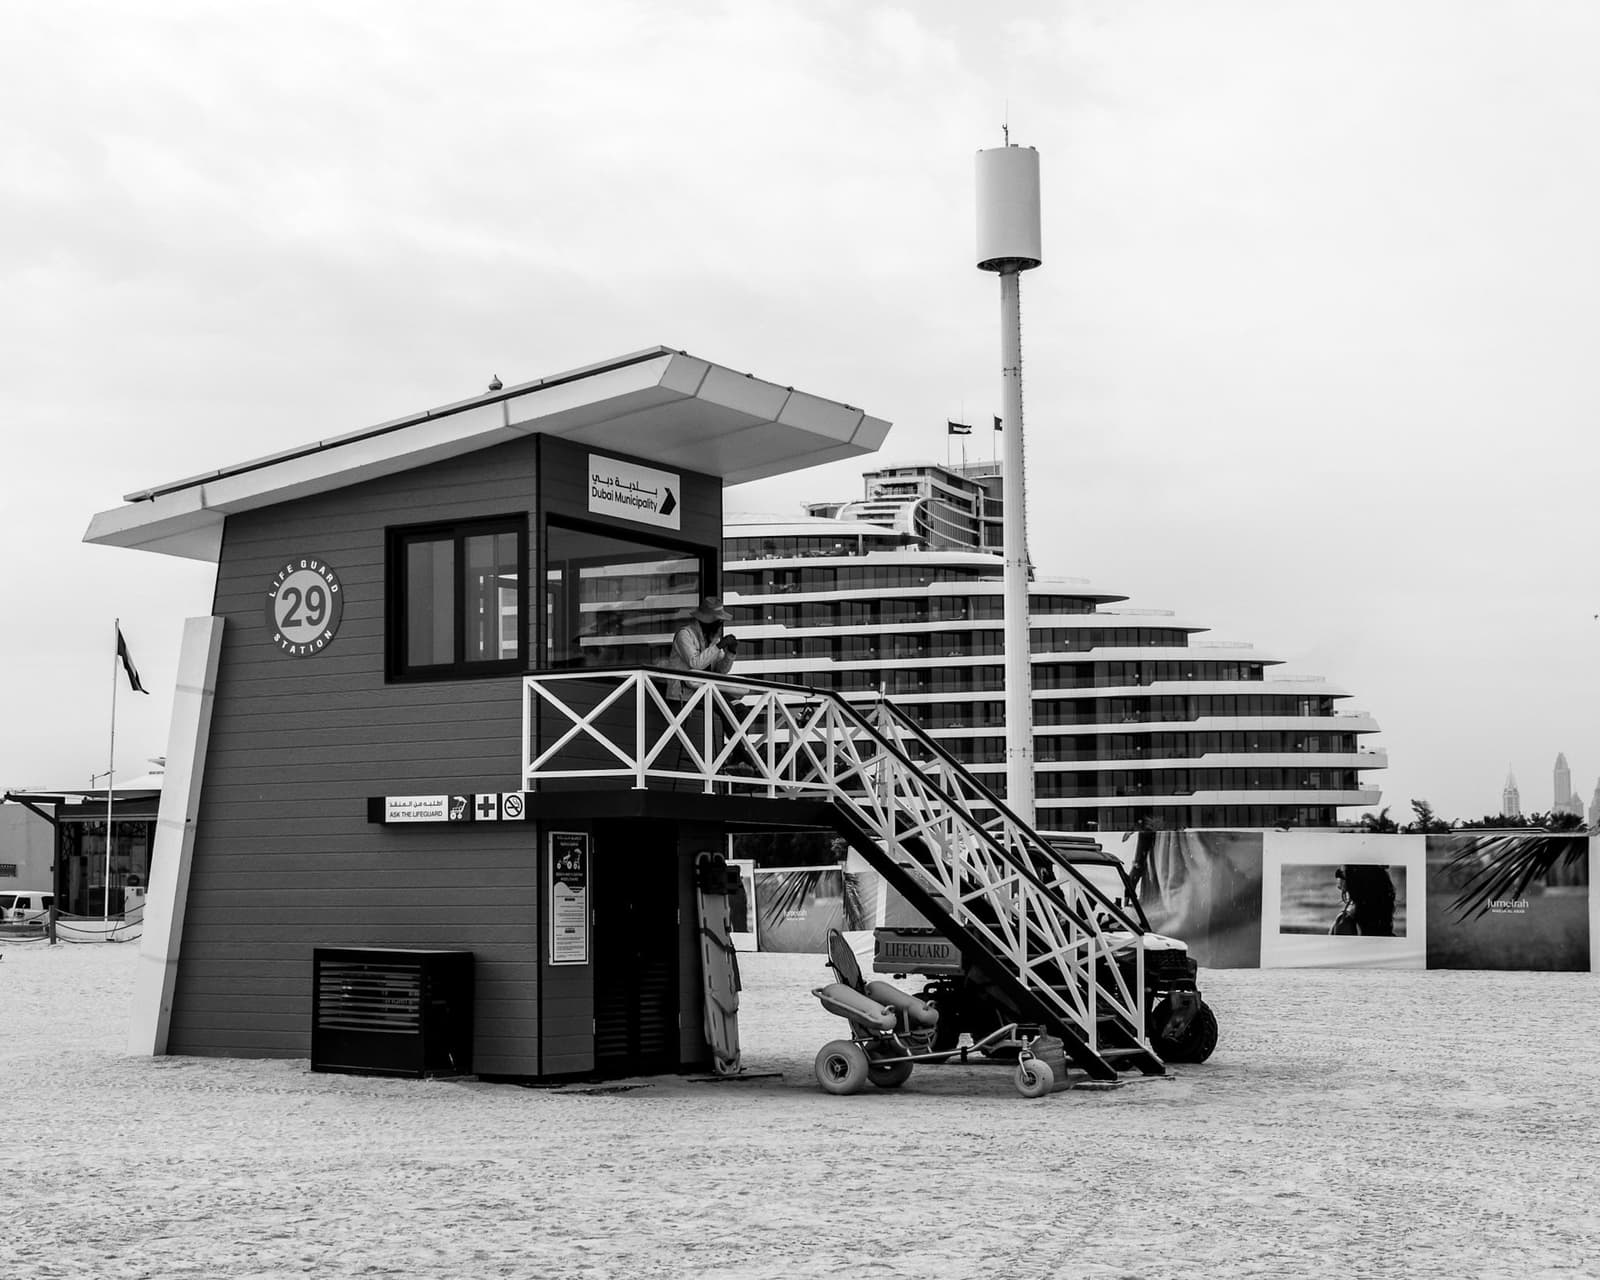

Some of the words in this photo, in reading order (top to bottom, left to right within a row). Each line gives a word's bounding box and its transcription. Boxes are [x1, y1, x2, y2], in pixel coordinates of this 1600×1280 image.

[592, 474, 613, 487] دبي
[592, 486, 614, 501] Dubai
[615, 491, 658, 512] Municipality
[268, 564, 294, 597] LIFE
[300, 560, 339, 593] GUARD
[281, 585, 326, 628] 29
[273, 630, 332, 654] STATION
[1487, 898, 1529, 908] Jumeirah
[885, 943, 950, 958] LIFEGUARD
